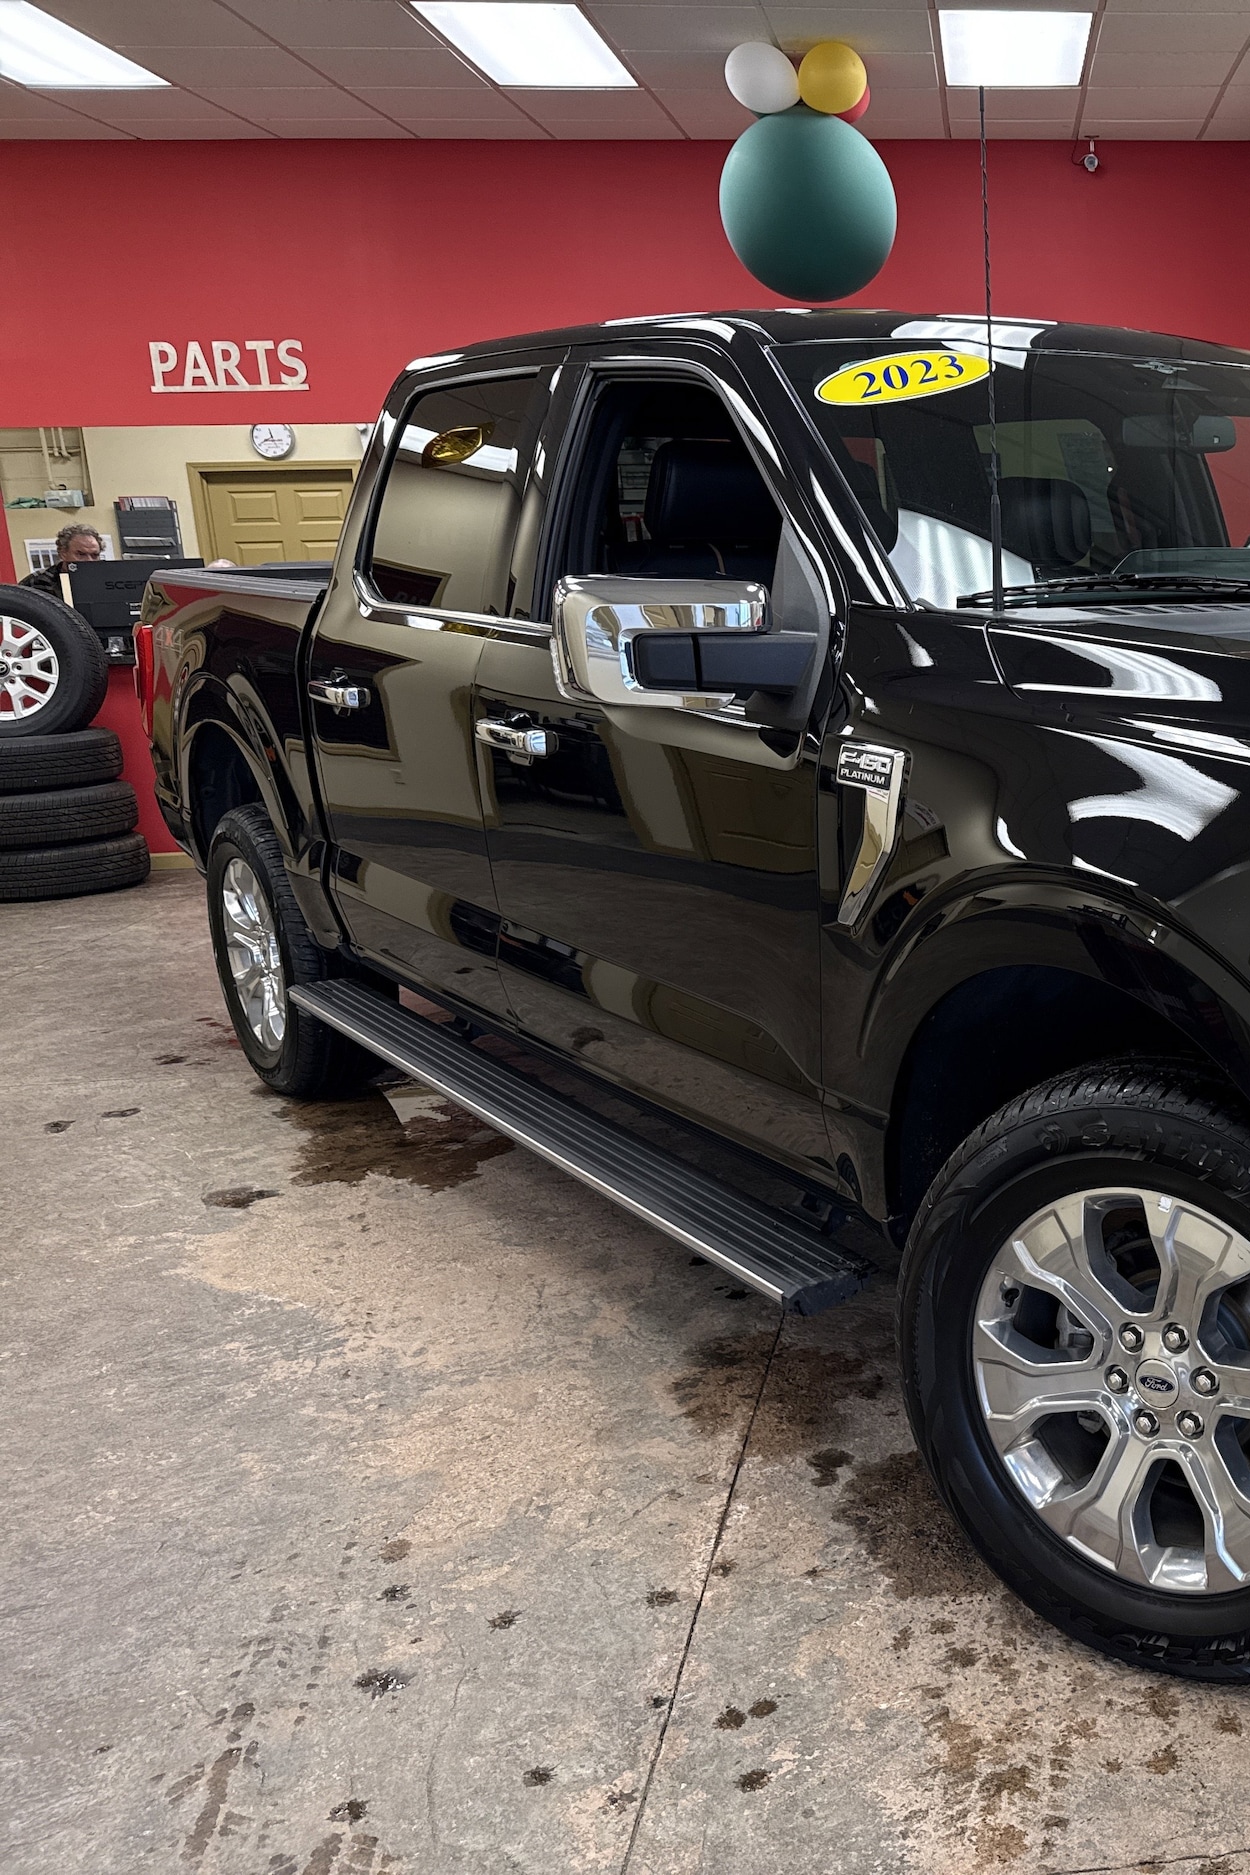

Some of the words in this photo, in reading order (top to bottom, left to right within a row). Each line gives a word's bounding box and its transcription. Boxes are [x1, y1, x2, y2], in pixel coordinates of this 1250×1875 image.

[148, 338, 309, 388] PARTS
[853, 354, 964, 399] 2023
[840, 751, 892, 774] F-150
[840, 768, 886, 785] PLATINUM
[1144, 1377, 1169, 1391] Ford
